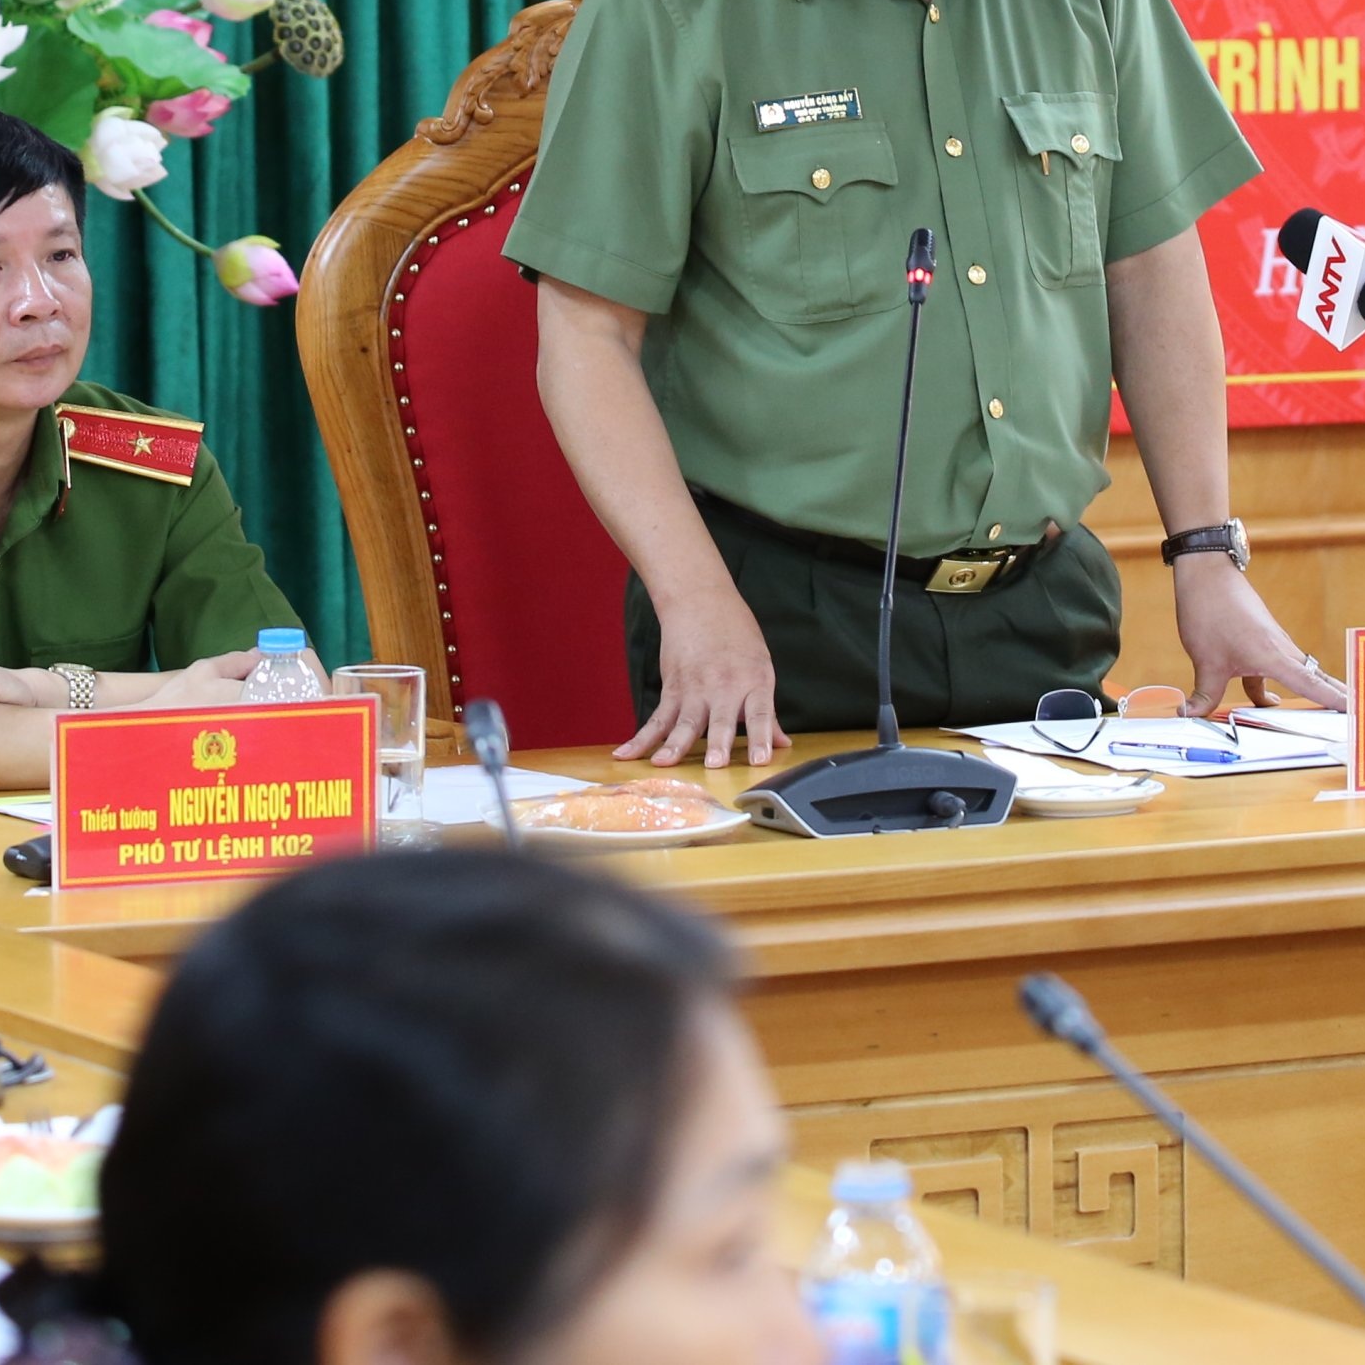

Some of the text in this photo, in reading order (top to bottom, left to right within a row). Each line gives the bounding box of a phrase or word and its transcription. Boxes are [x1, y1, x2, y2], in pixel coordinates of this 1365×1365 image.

[1254, 228, 1307, 297] H
[1315, 234, 1346, 335] ANTV
[80, 772, 352, 832] Thiếu tướng NGUYỄN NGỌC THANH
[119, 834, 313, 866] PHÓ TƯ LỆNH K02
